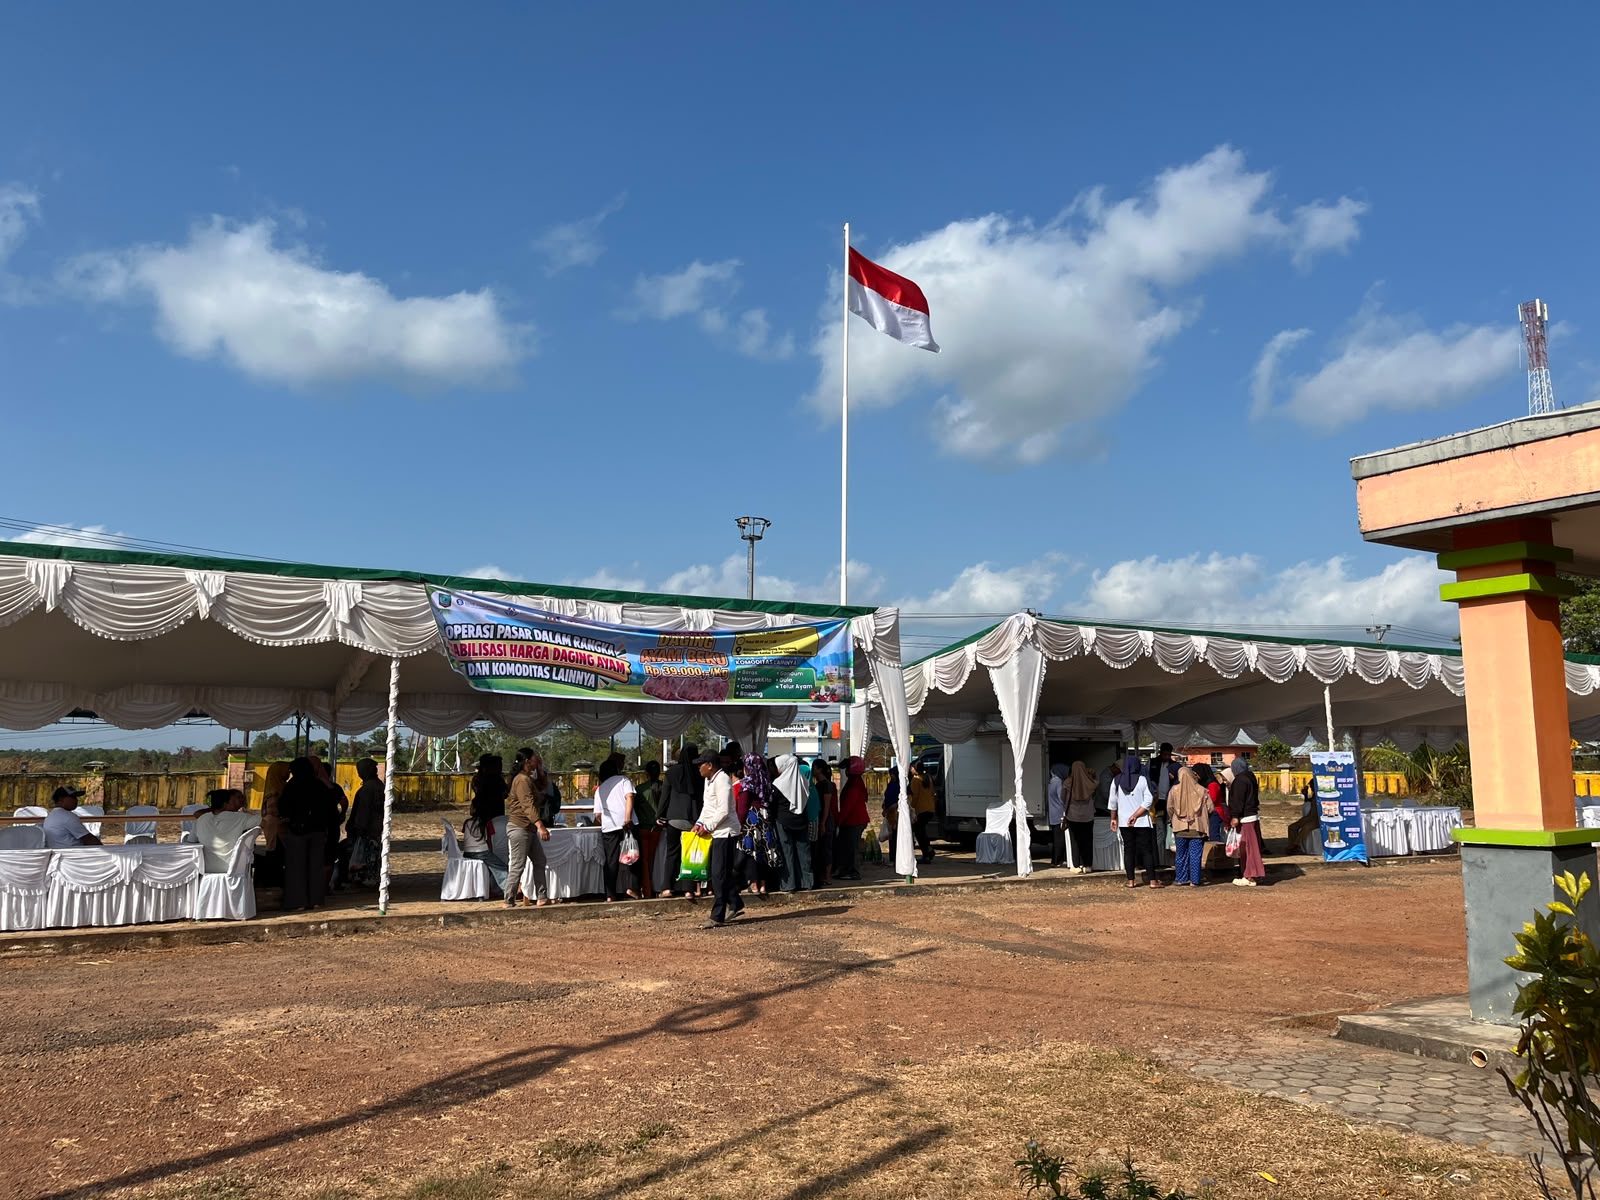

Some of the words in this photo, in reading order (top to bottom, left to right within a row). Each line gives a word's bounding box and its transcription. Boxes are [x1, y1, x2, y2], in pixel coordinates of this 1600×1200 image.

[446, 624, 495, 639] OPERASI
[497, 625, 533, 640] PASAR
[533, 629, 572, 646] DALAM
[573, 635, 615, 656] RANGKA
[658, 634, 714, 649] DAGING
[449, 642, 507, 656] ABILISASI
[509, 644, 549, 659] HARGA
[553, 647, 595, 666] DAGING
[597, 656, 626, 675] AYAM
[640, 649, 683, 662] AYAM
[686, 649, 728, 665] BEKU
[467, 662, 490, 676] DAN
[491, 662, 550, 680] KOMODITAS
[552, 667, 595, 688] LAINNYA
[645, 665, 660, 676] Rp
